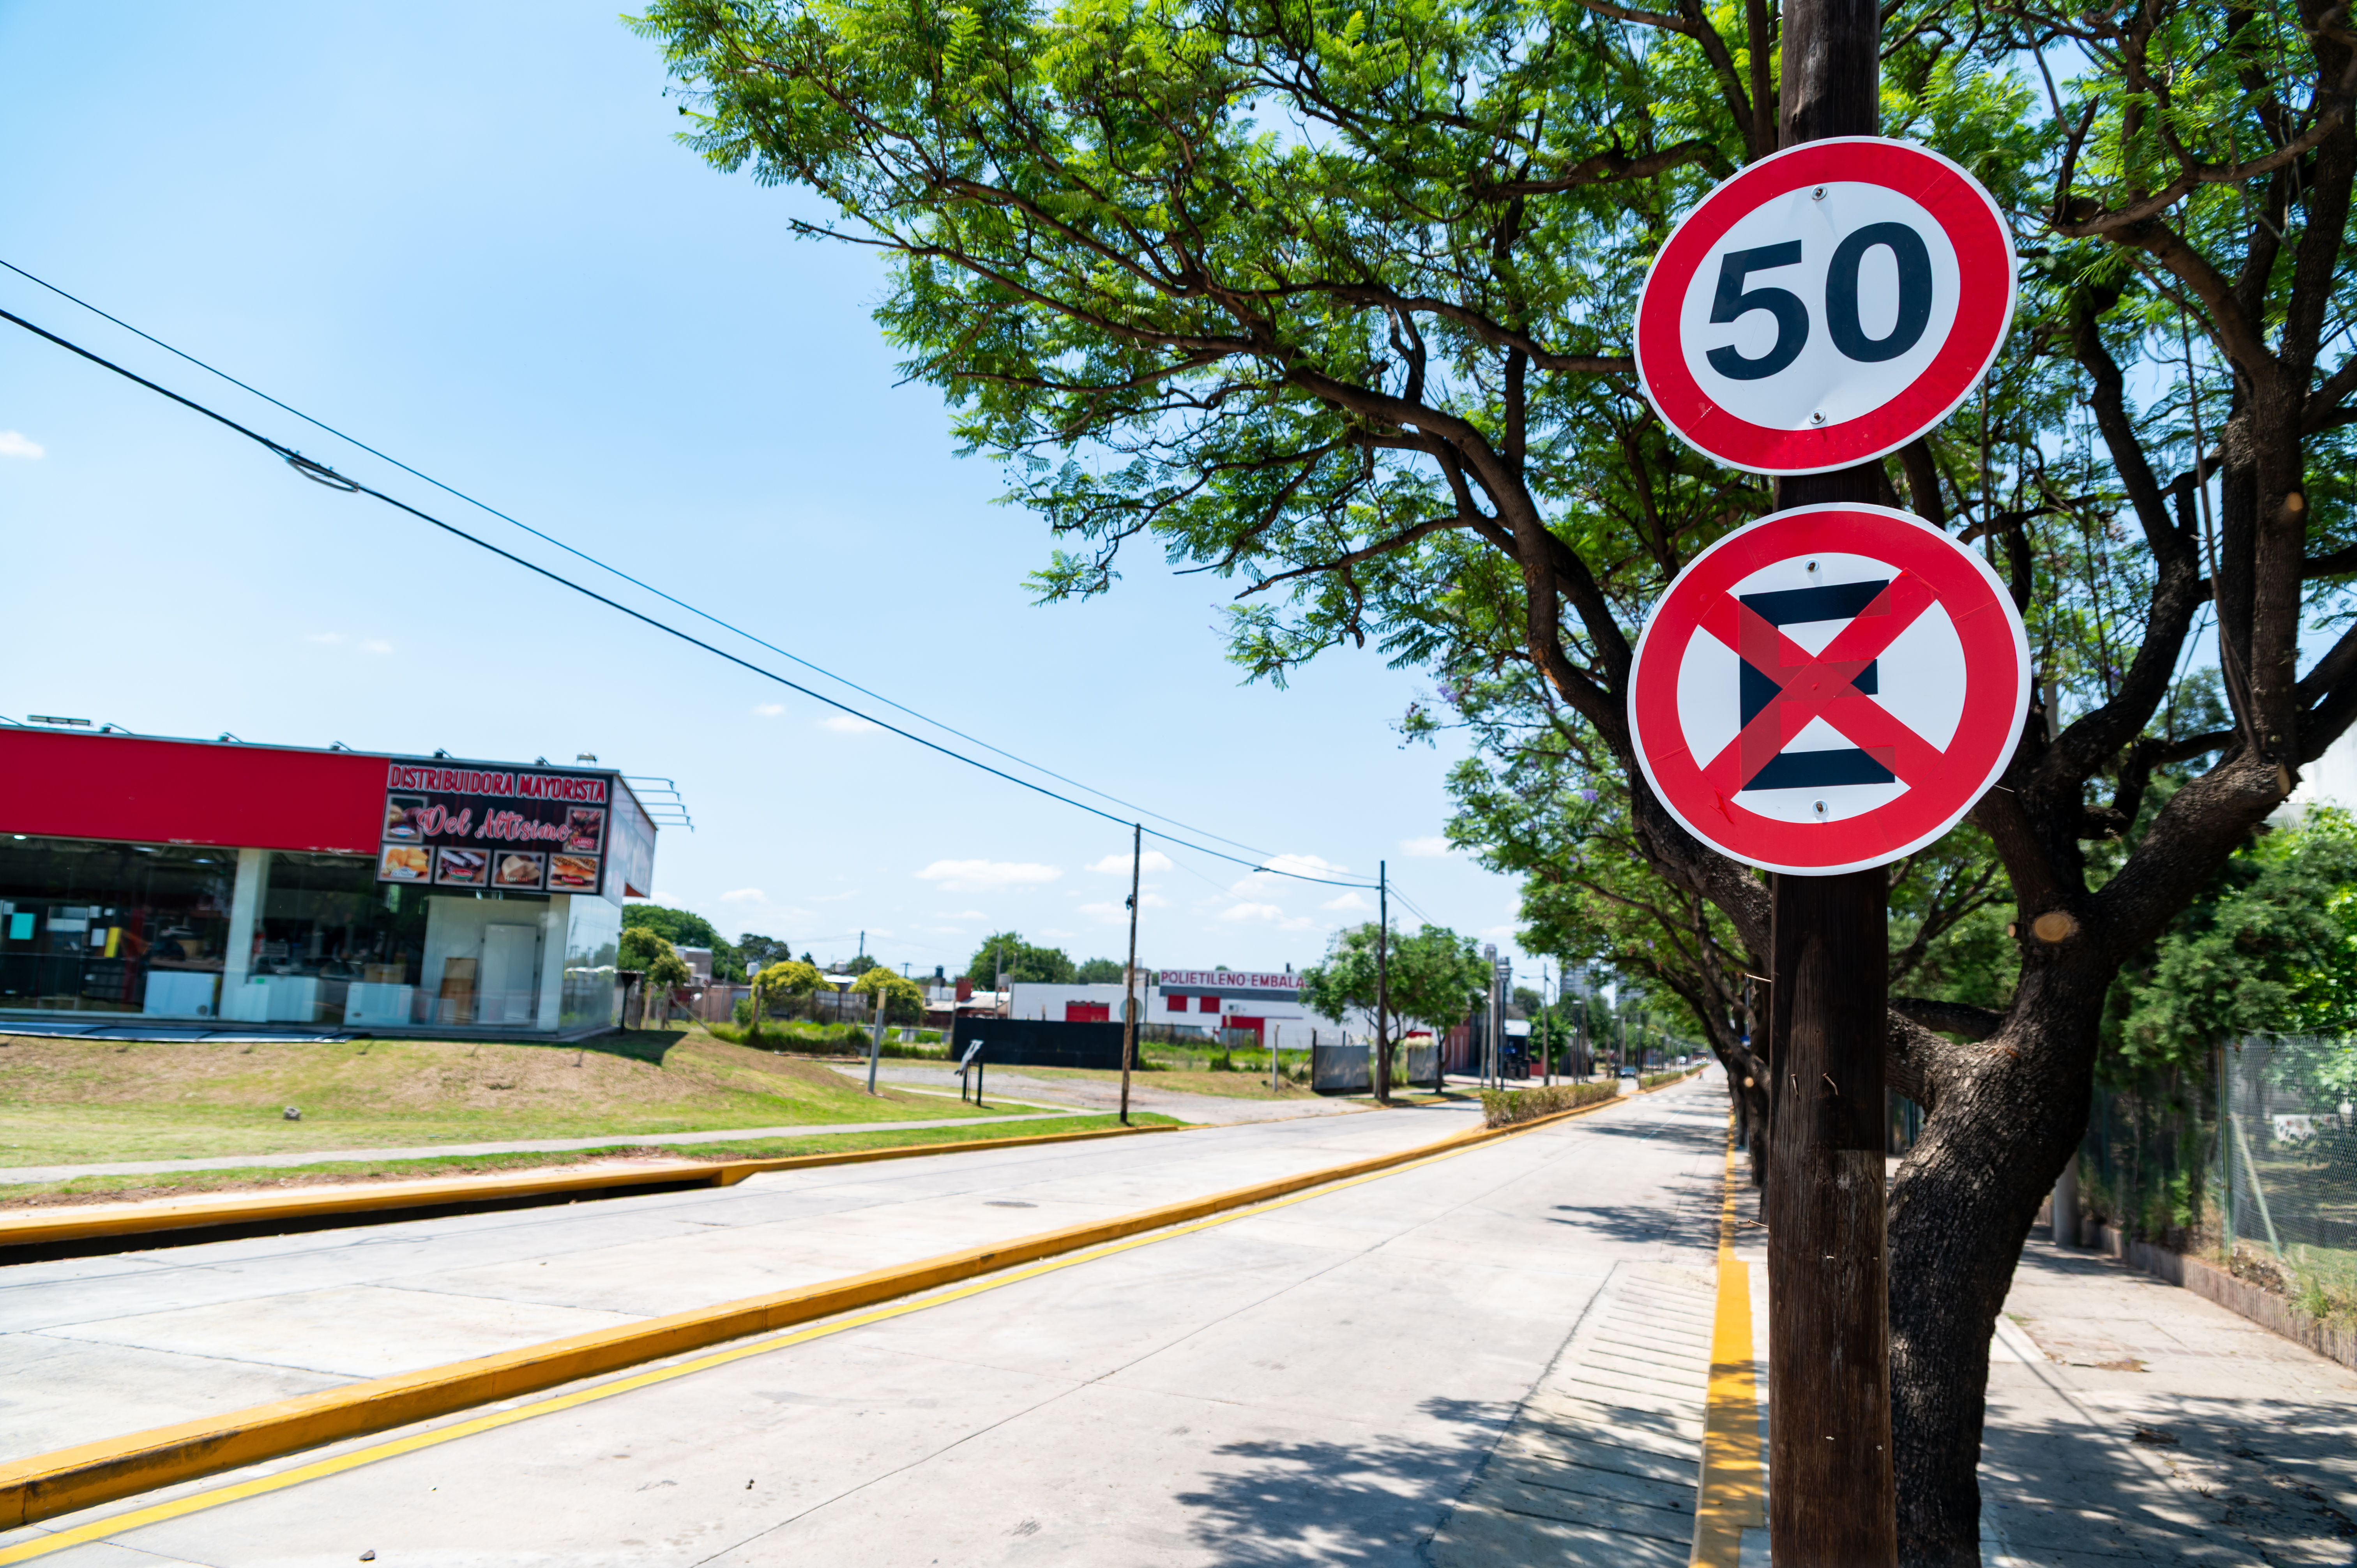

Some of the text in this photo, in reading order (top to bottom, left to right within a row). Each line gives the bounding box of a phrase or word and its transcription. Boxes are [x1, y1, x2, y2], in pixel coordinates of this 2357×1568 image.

[1706, 221, 1933, 380] 50
[1739, 579, 1896, 791] E
[388, 765, 608, 803] DISTRIBUIDORA MAYORISTA
[417, 804, 572, 842] Del Altisimo
[1161, 971, 1308, 988] POLIETILENO EMBALA
